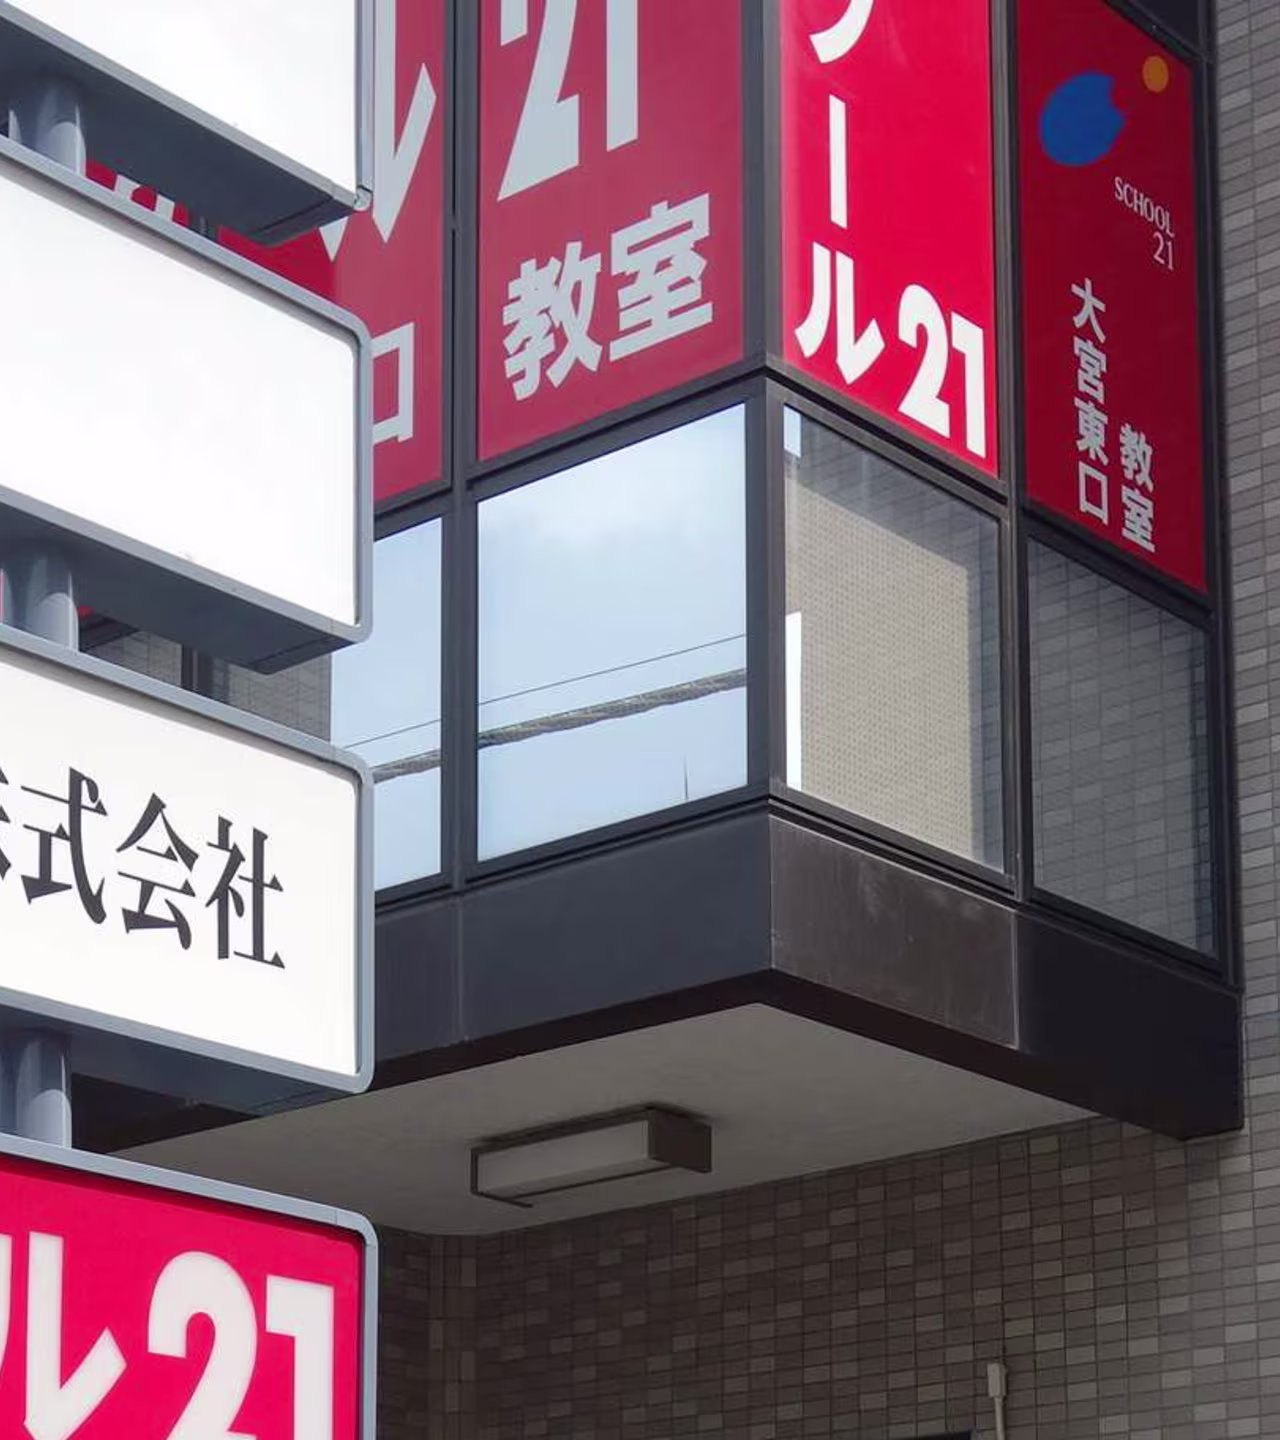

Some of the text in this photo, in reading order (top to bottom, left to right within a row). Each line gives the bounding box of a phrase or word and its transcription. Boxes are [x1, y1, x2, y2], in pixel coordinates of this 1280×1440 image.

[1113, 175, 1176, 238] SCHOOL
[1152, 231, 1176, 272] 21
[501, 192, 713, 402] 教室
[897, 283, 986, 459] 21
[1070, 277, 1110, 526] 大宮東口
[1119, 422, 1156, 554] 教室
